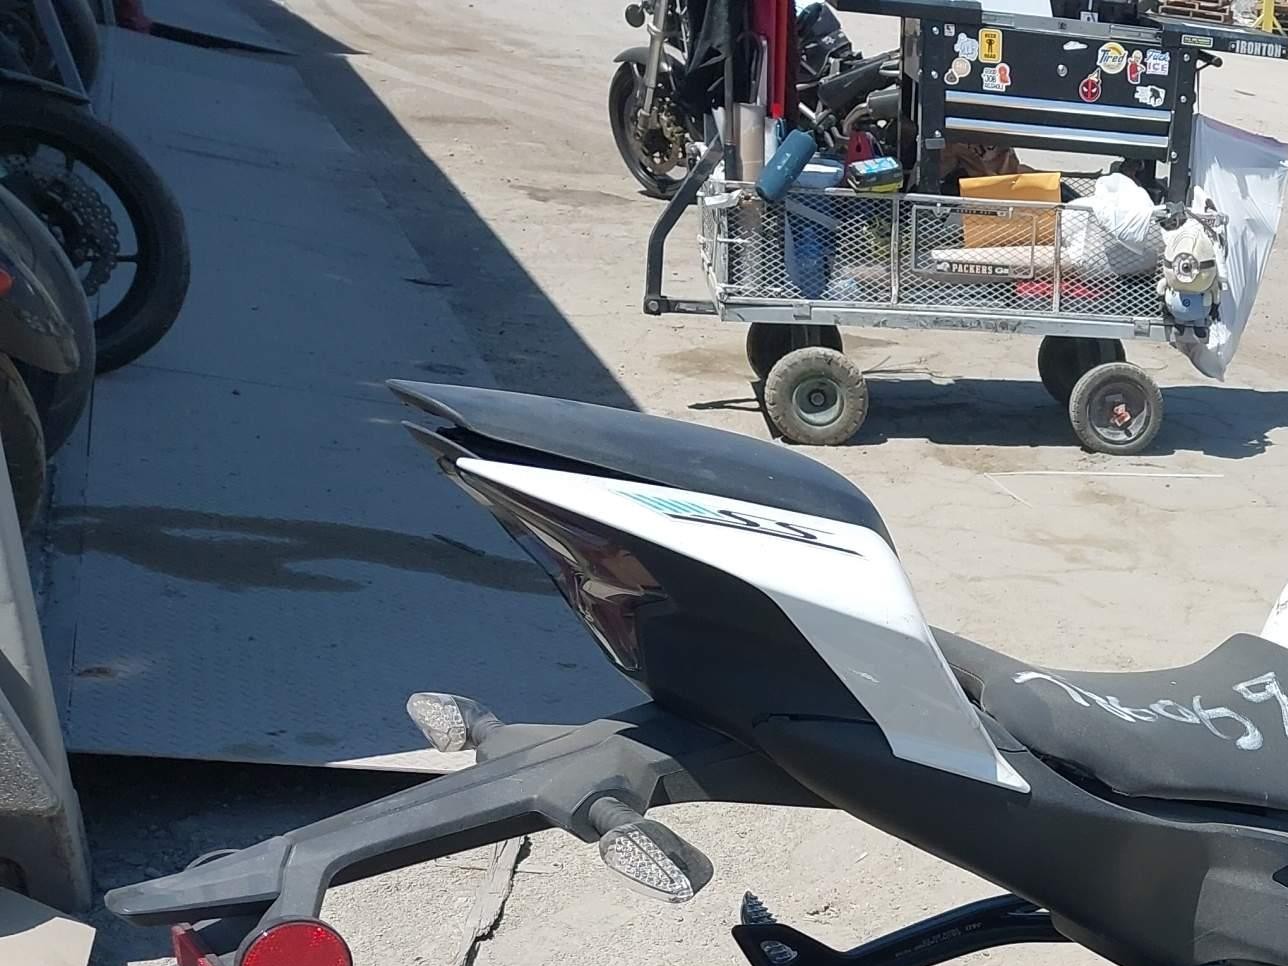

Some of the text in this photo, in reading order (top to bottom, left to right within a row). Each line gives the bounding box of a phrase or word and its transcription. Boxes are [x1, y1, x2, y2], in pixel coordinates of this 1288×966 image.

[1099, 48, 1127, 63] Tired
[1235, 40, 1282, 58] IRONTON
[1148, 62, 1168, 72] ICE
[952, 262, 993, 275] PACKERS
